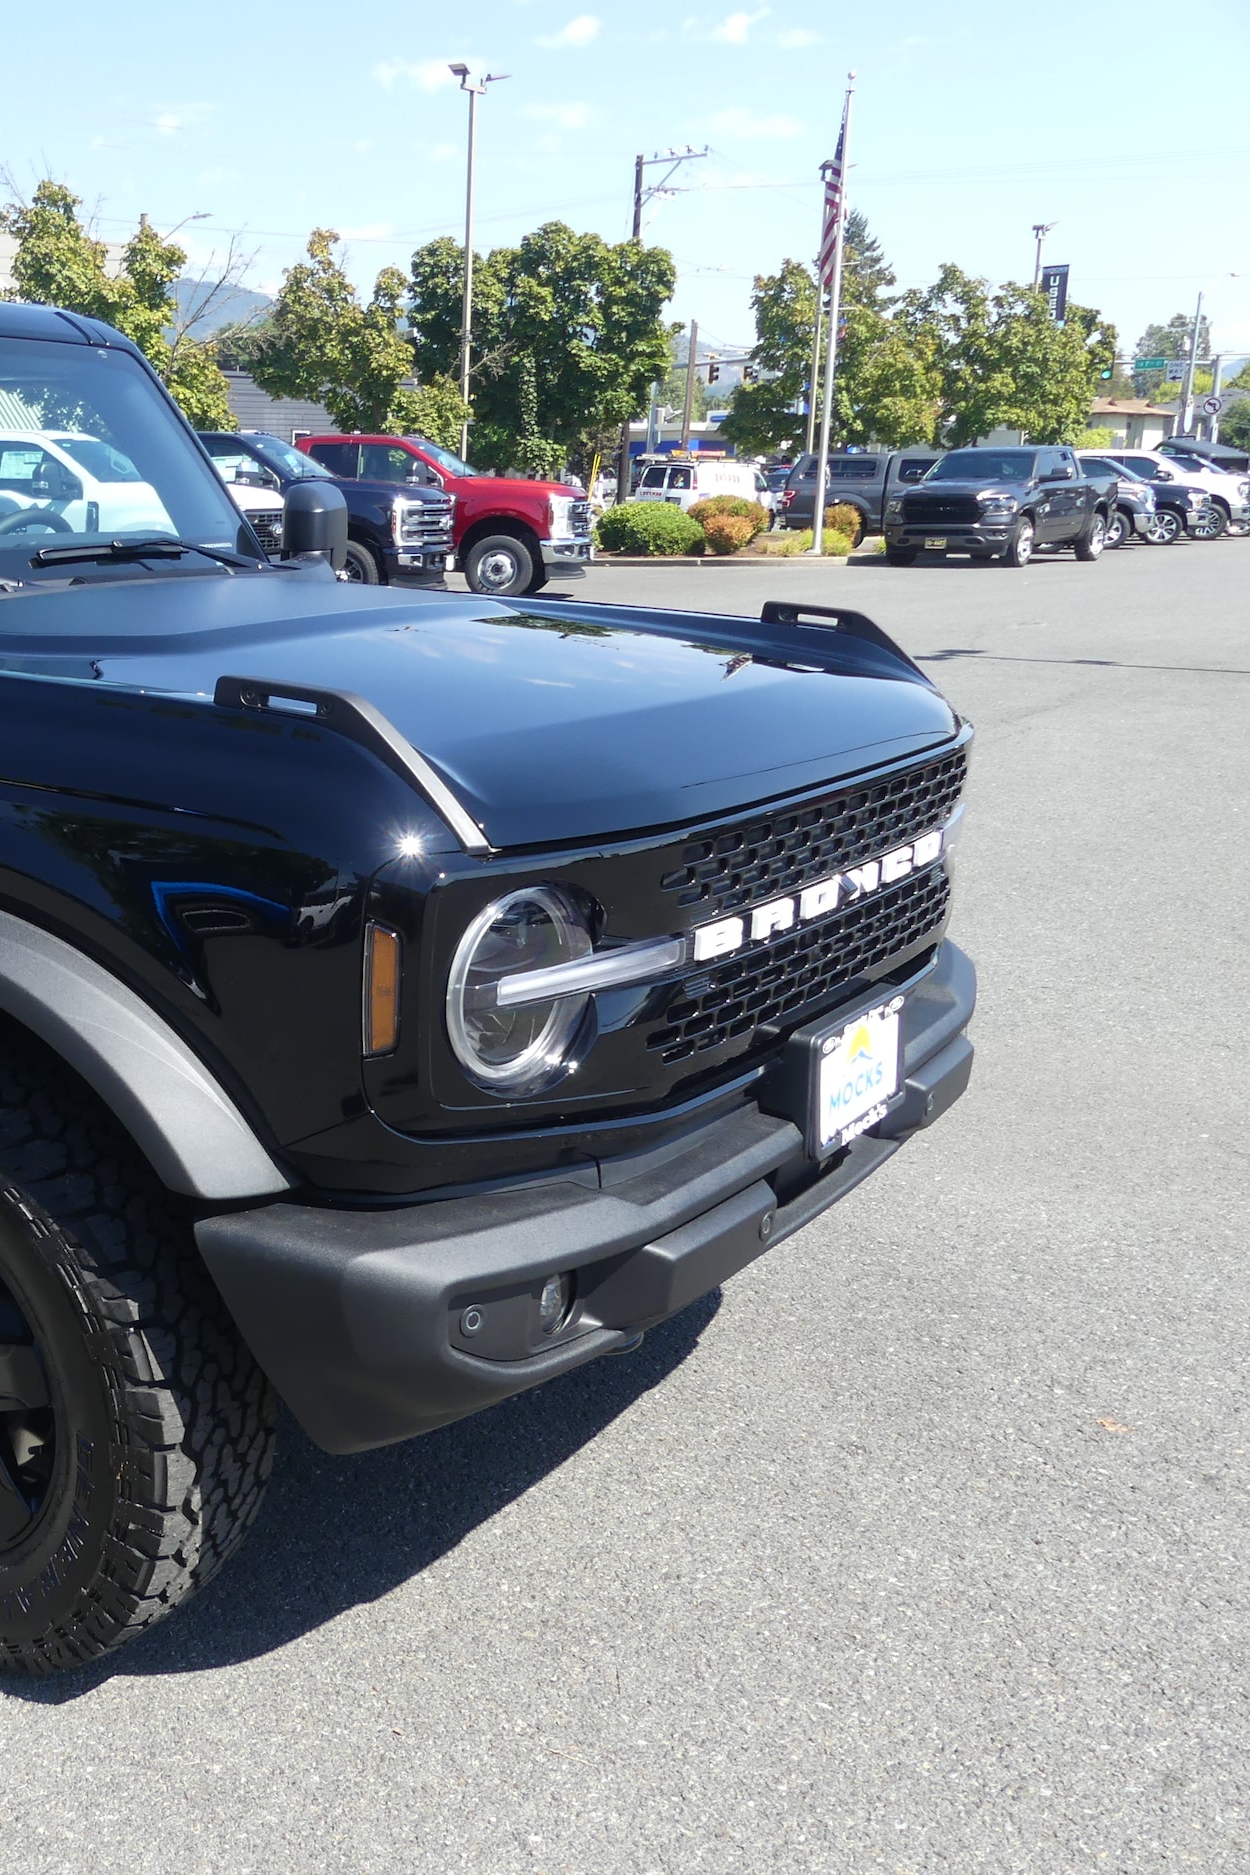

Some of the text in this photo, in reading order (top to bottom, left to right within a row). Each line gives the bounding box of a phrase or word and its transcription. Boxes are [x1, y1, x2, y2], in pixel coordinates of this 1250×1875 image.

[1049, 275, 1060, 320] USED
[694, 831, 942, 962] BRONCO
[830, 1061, 883, 1115] MOCKS
